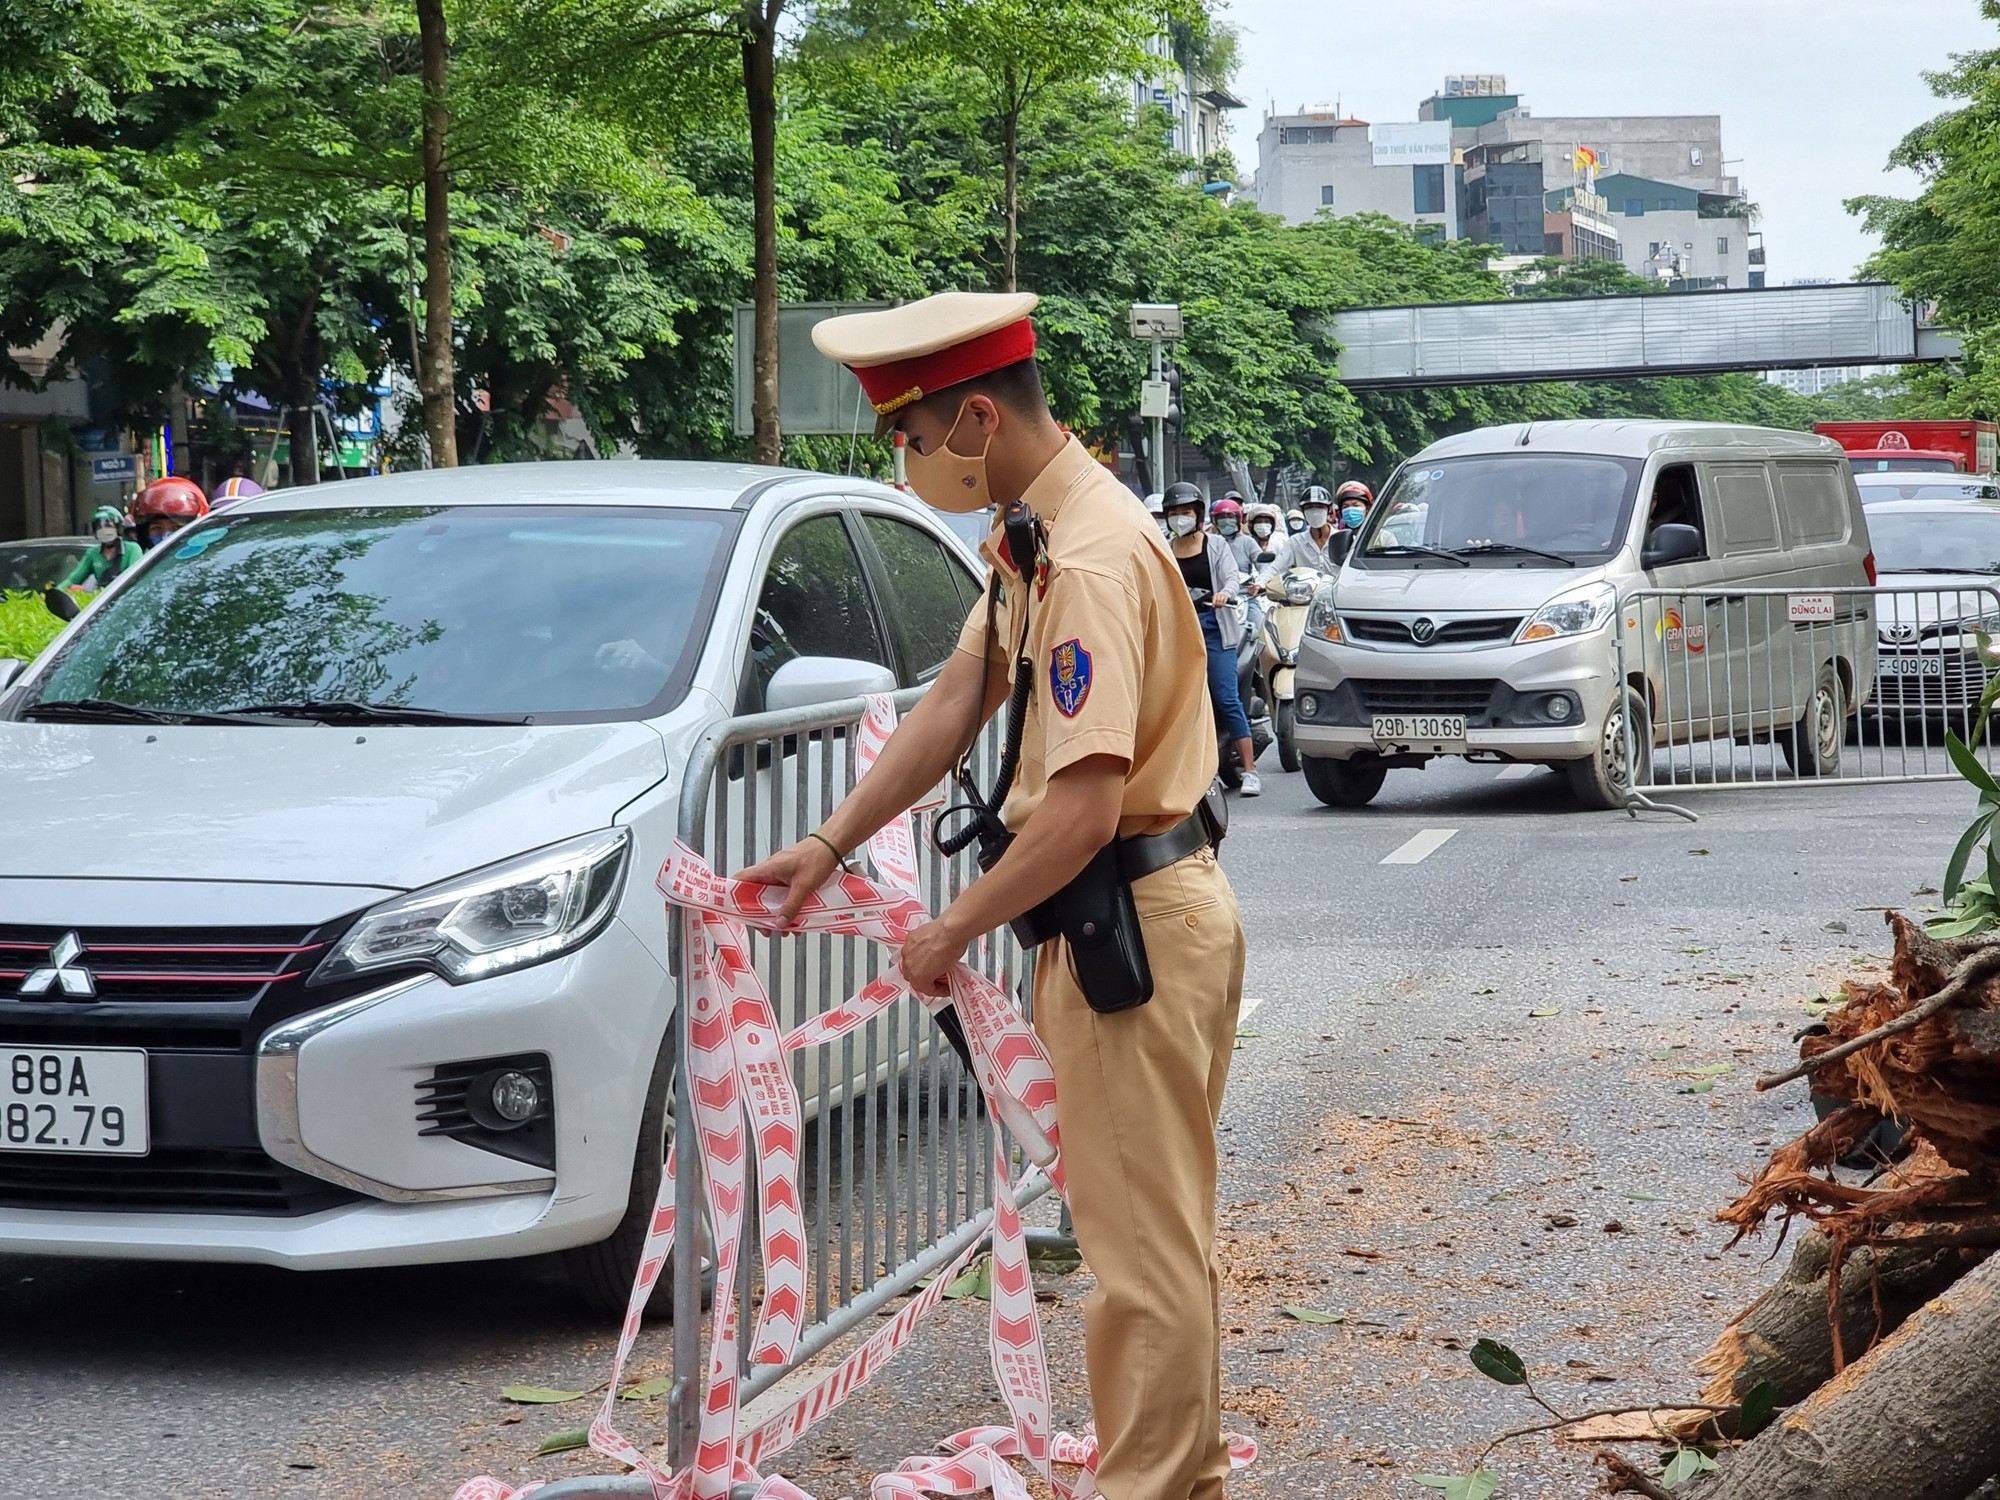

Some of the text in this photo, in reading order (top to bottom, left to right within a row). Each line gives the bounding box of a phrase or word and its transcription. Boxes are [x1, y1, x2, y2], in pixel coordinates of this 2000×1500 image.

[1375, 718, 1462, 737] 29D-130.69
[12, 1055, 89, 1097] 88A
[0, 1104, 125, 1147] 82.79
